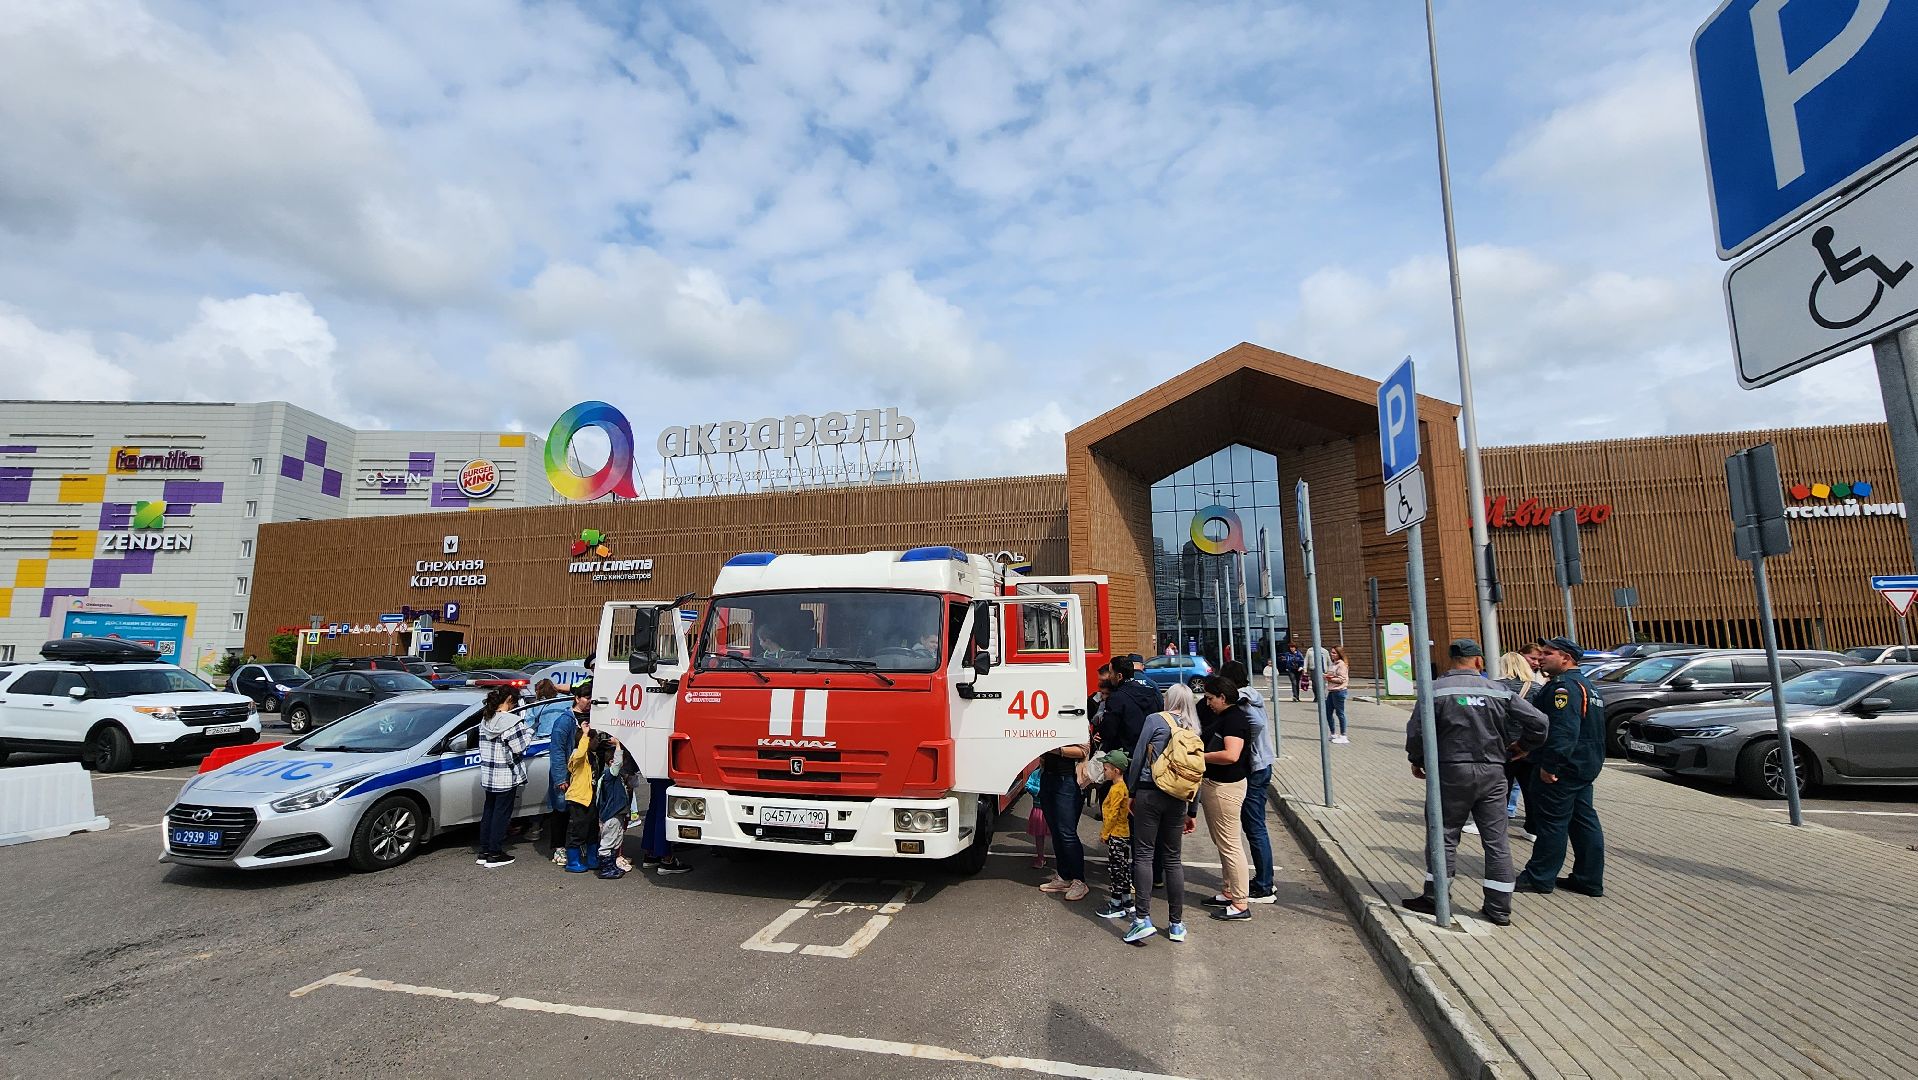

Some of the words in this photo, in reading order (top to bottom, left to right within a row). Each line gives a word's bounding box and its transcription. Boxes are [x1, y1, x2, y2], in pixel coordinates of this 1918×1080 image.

[657, 407, 915, 458] акварель
[1386, 384, 1406, 468] P
[116, 450, 203, 470] familia
[463, 466, 493, 479] BURGER
[463, 472, 494, 488] KING
[102, 532, 192, 550] ZENDEN
[608, 573, 652, 581] кинотеатров
[447, 604, 457, 619] P
[614, 683, 643, 711] 40
[1007, 690, 1050, 720] 40
[610, 718, 646, 728] ПУШКИНО
[1004, 730, 1057, 738] ПУШКИНО
[757, 738, 837, 749] KAMAZ
[807, 811, 824, 821] 190
[182, 830, 205, 843] 2939
[209, 831, 219, 841] 50
